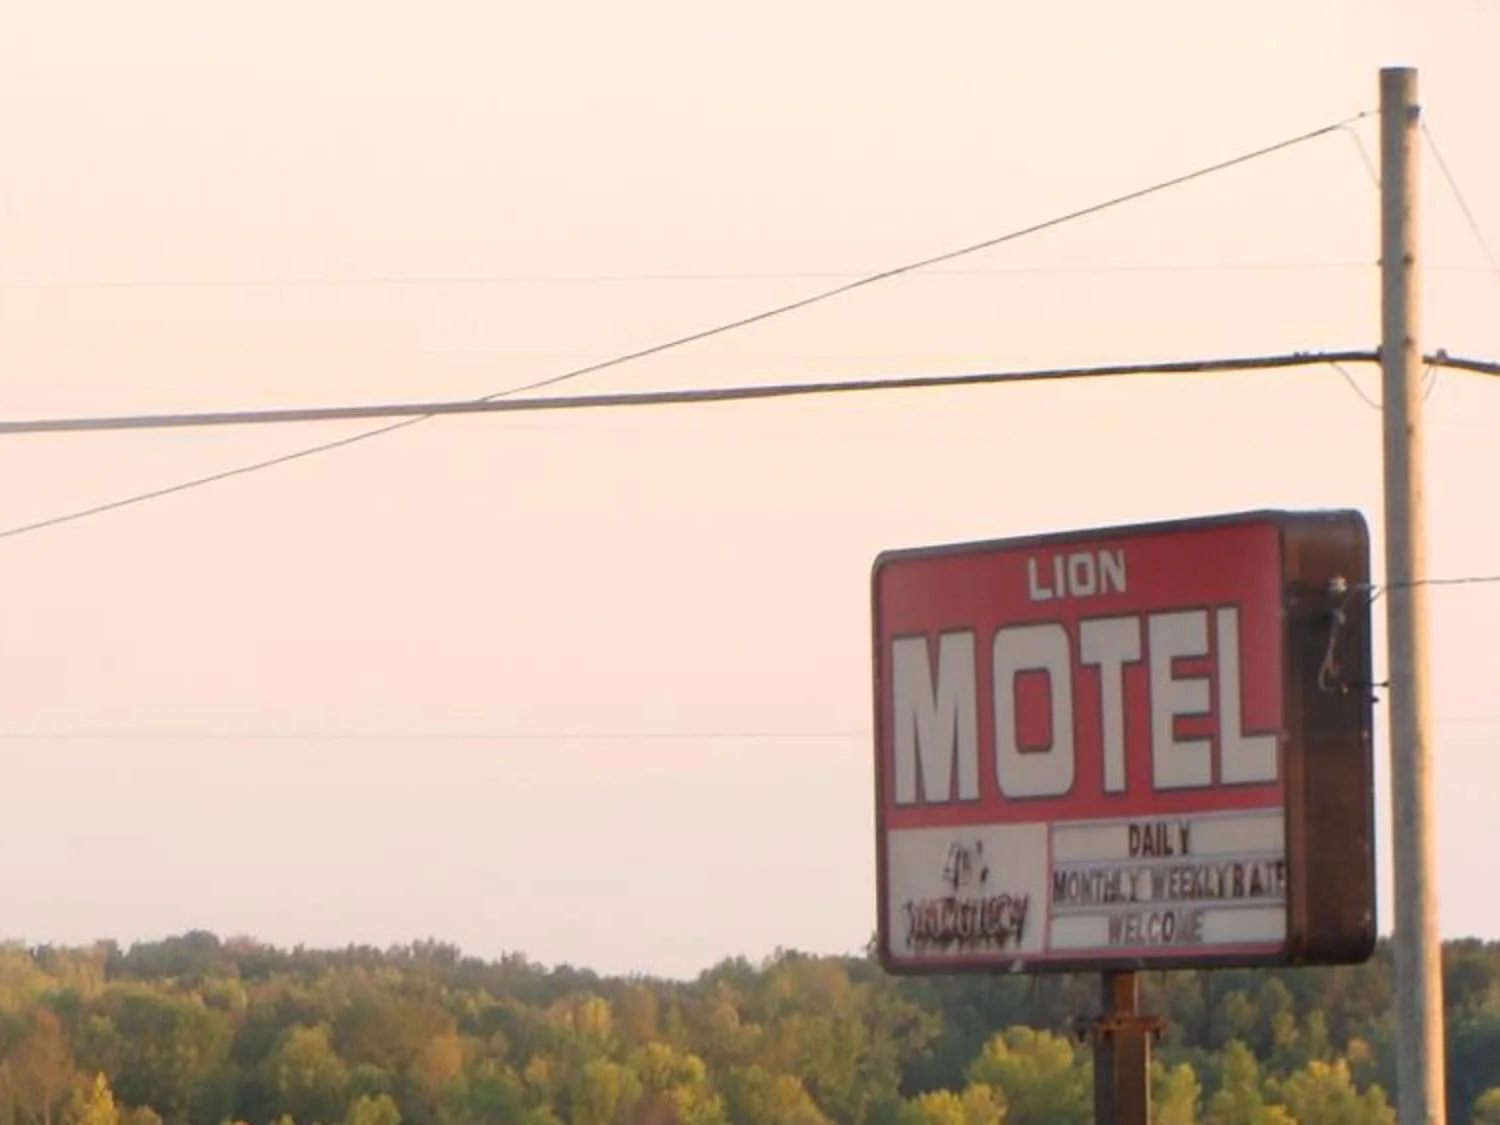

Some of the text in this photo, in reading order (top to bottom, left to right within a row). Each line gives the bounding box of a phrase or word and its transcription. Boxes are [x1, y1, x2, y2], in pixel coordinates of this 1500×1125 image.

[1027, 549, 1127, 601] LION
[891, 606, 1280, 805] MOTEL
[1127, 820, 1190, 856] DAILY
[1053, 868, 1139, 903] MONTHLY
[1151, 862, 1227, 899] WEEKLY
[1107, 909, 1203, 945] WELCOME
